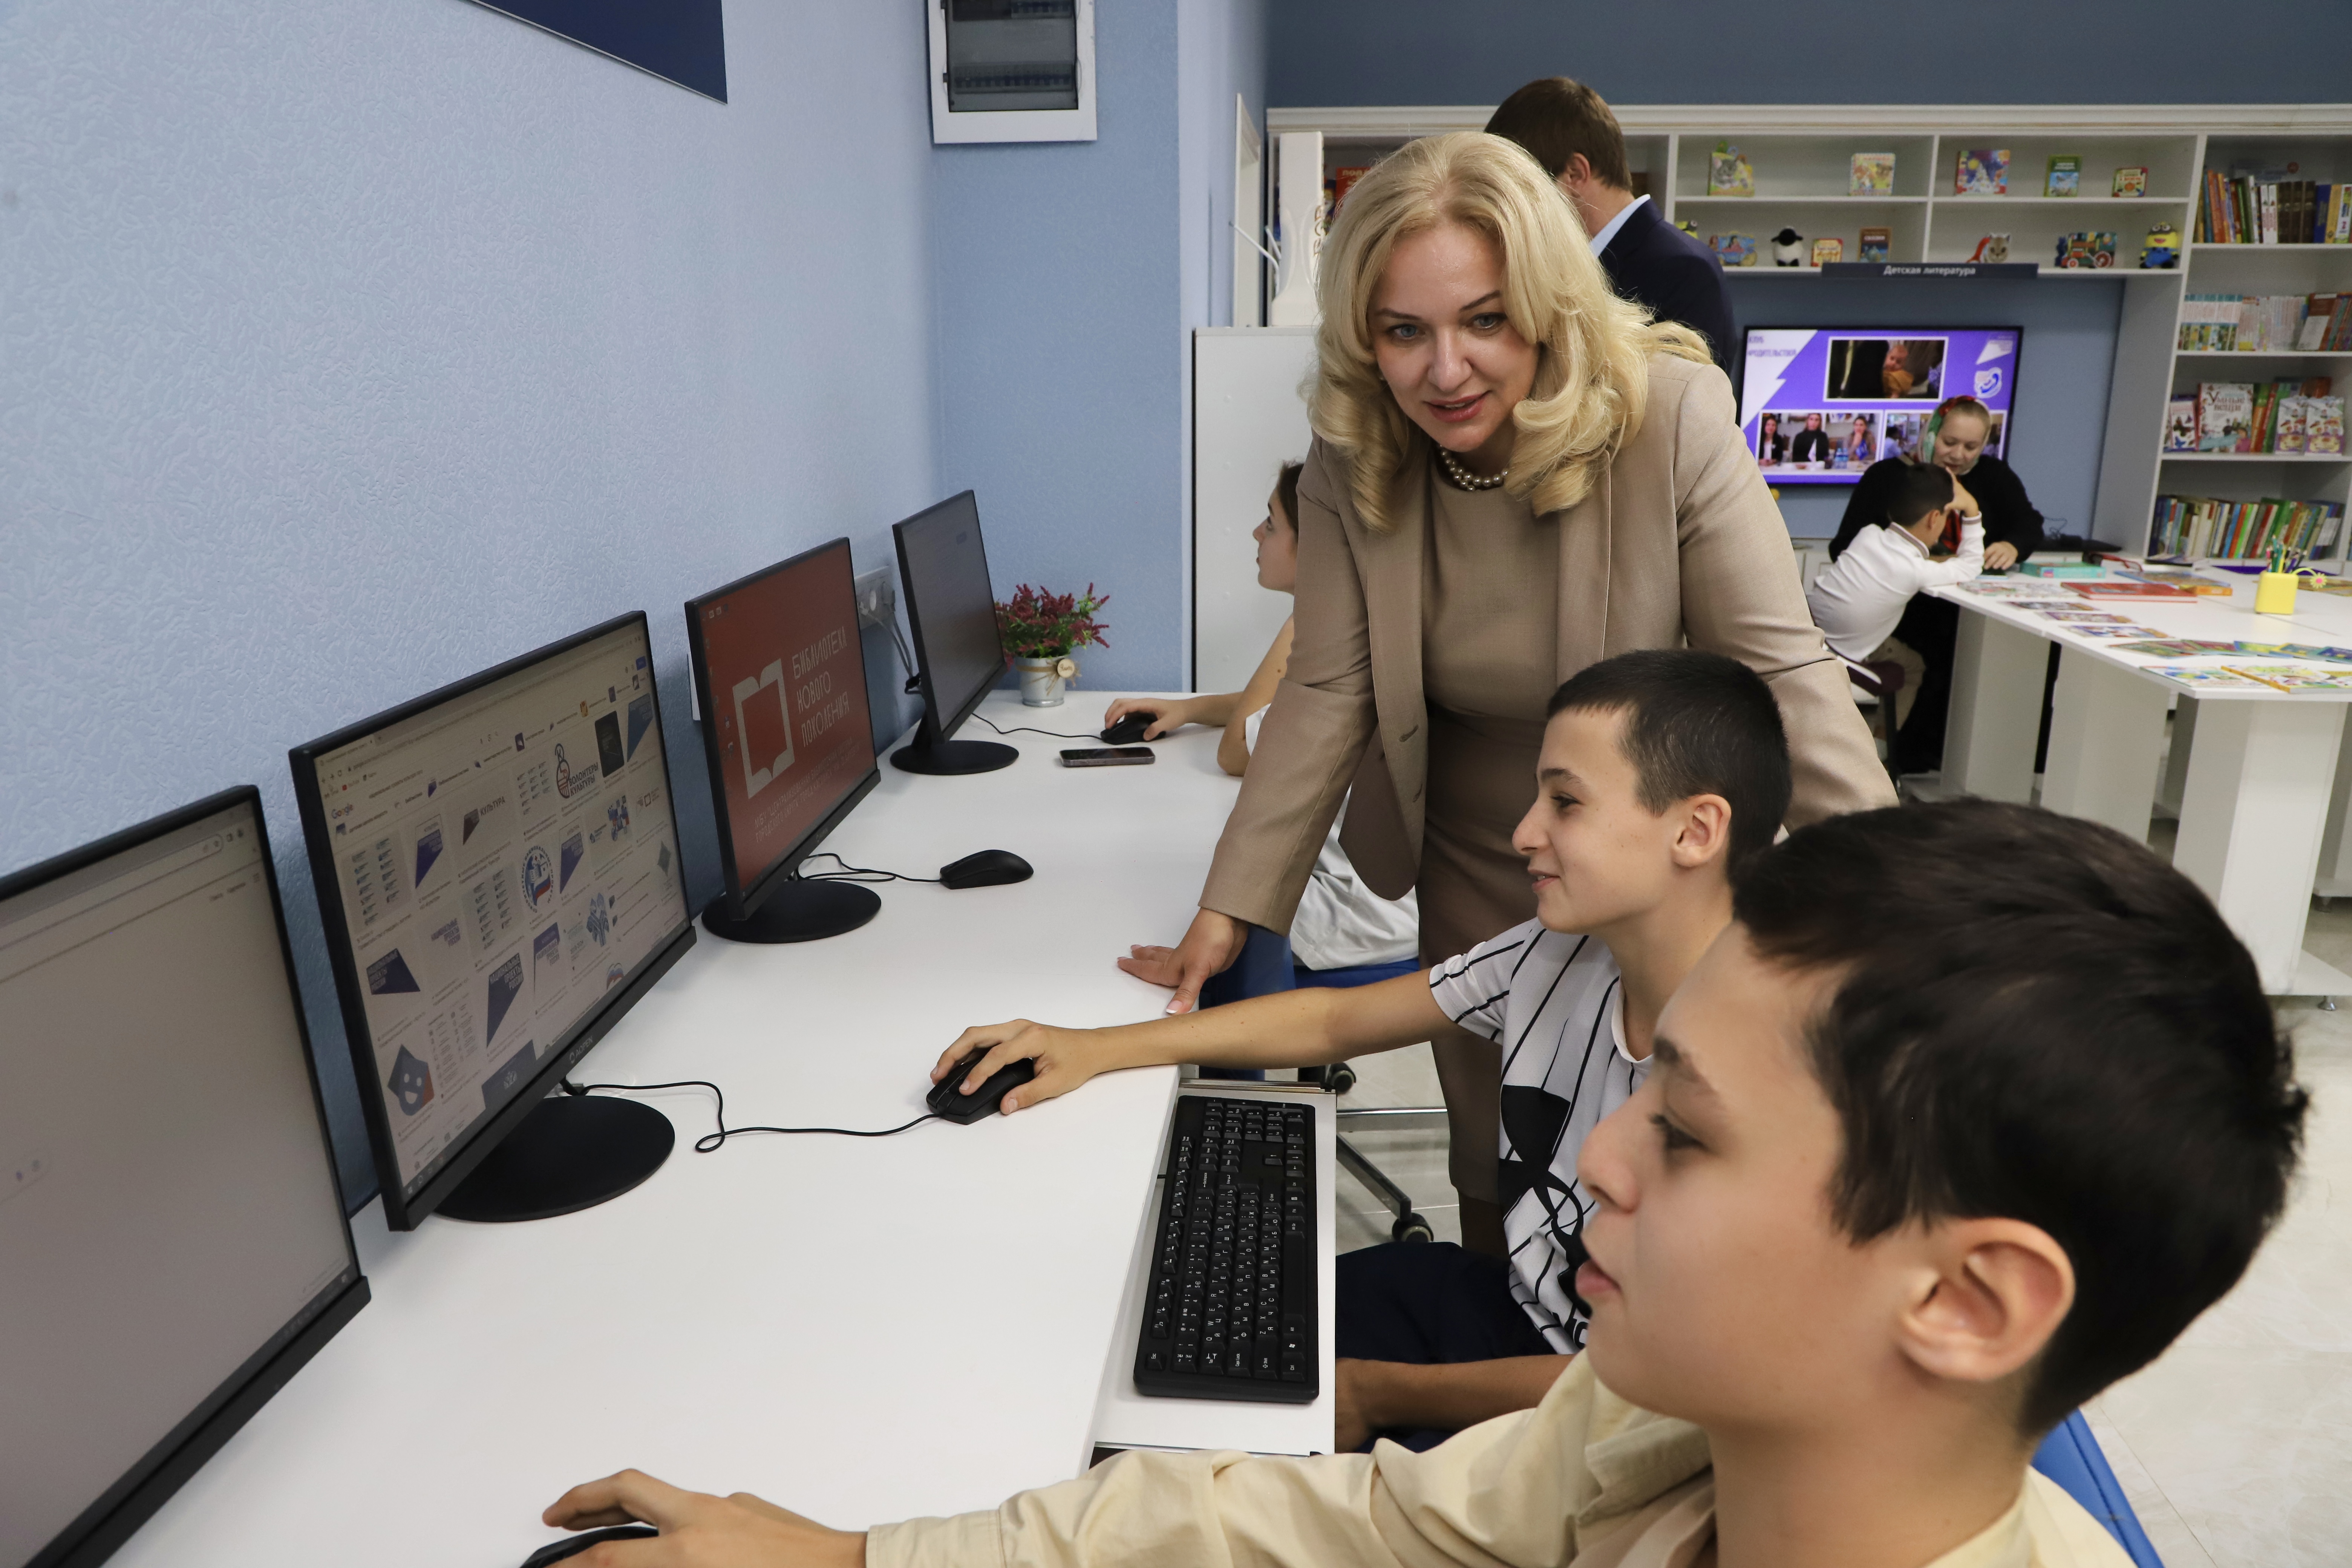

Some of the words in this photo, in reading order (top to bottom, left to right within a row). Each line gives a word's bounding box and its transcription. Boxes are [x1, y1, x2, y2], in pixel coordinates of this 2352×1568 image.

[1883, 265, 1921, 276] Детская
[1923, 267, 1976, 276] литература
[791, 625, 847, 681] БИБЛИОТЕКА
[796, 669, 831, 714] НОВОГО
[801, 691, 850, 748] ПОКОЛЕНИЯ
[568, 761, 599, 788] ВОЛОНТЕРЫ
[570, 773, 595, 797] КУЛЬТУРЫ
[330, 800, 354, 822] Google
[479, 794, 505, 817] КУЛЬТУРА
[754, 810, 767, 830] МБУ
[755, 810, 784, 845] ГОРОДСКОГО
[576, 1036, 593, 1058] AOPEN
